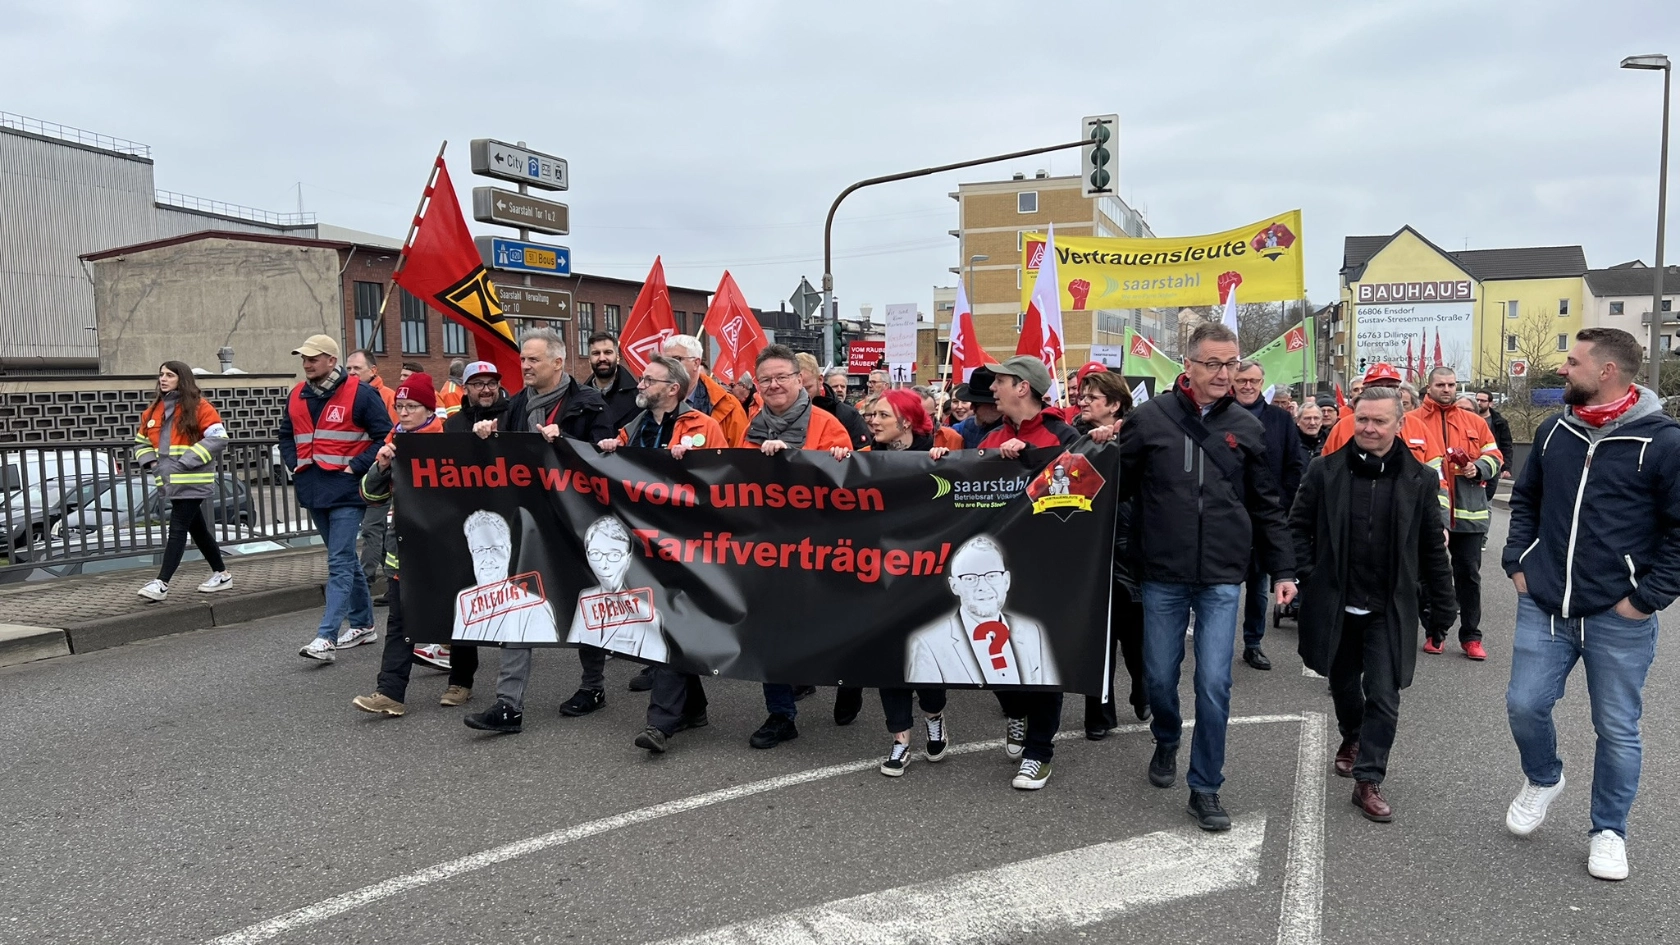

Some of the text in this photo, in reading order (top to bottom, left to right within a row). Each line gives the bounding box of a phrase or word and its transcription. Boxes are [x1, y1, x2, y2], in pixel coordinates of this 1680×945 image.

[507, 154, 523, 172] City
[509, 202, 533, 217] Saarstahl
[535, 207, 543, 219] Tor
[538, 254, 554, 266] Bous
[1054, 240, 1246, 266] Vertrauensleute
[1122, 272, 1200, 291] saarstahl
[1361, 282, 1468, 298] BAUHAUS
[500, 289, 550, 305] Saarstahl Verwaltung
[501, 302, 520, 312] Tor 10
[1358, 314, 1462, 324] Gustav-Stresemann-Straße
[1384, 332, 1418, 340] Dillingen
[410, 458, 884, 511] Hände weg von unseren
[954, 476, 1030, 492] saarstahl
[632, 528, 952, 584] Tarifverträgen!
[471, 582, 528, 614] ERLEDIGT
[592, 598, 640, 620] ERLEDIGT
[972, 620, 1010, 670] ?
